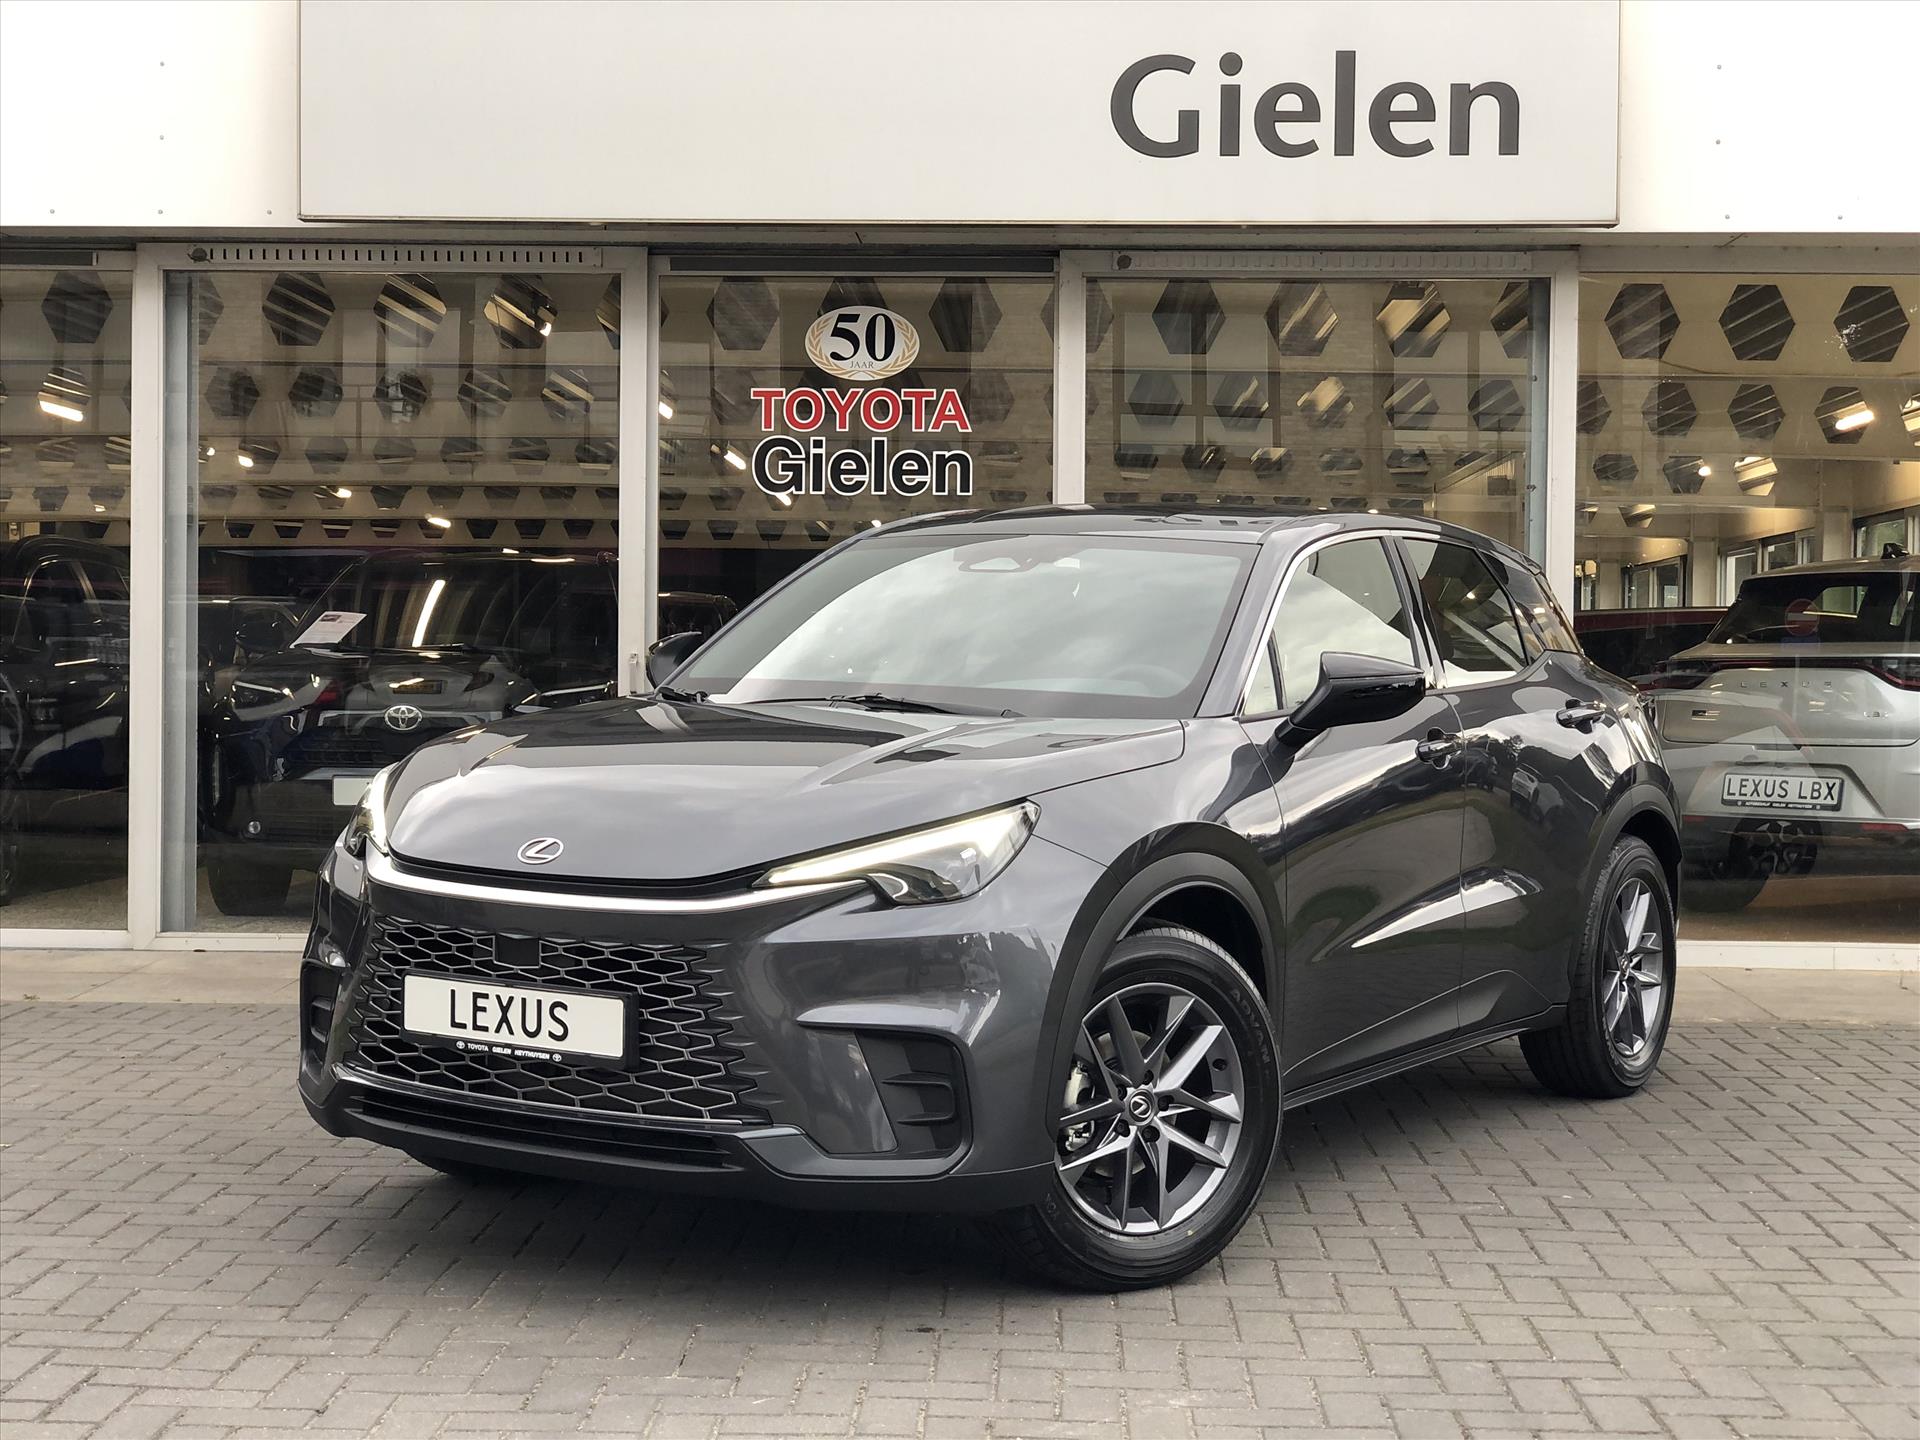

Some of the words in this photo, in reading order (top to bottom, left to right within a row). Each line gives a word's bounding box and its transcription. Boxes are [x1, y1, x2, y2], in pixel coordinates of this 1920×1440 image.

[1110, 50, 1520, 159] Gielen
[829, 313, 896, 362] 50
[849, 361, 875, 369] JAAR
[750, 387, 972, 433] TOYOTA
[751, 435, 973, 497] Gielen
[1727, 778, 1789, 799] LEXUS
[1798, 781, 1837, 801] LBX
[450, 989, 569, 1042] LEXUS
[467, 1043, 489, 1052] TOYOTA
